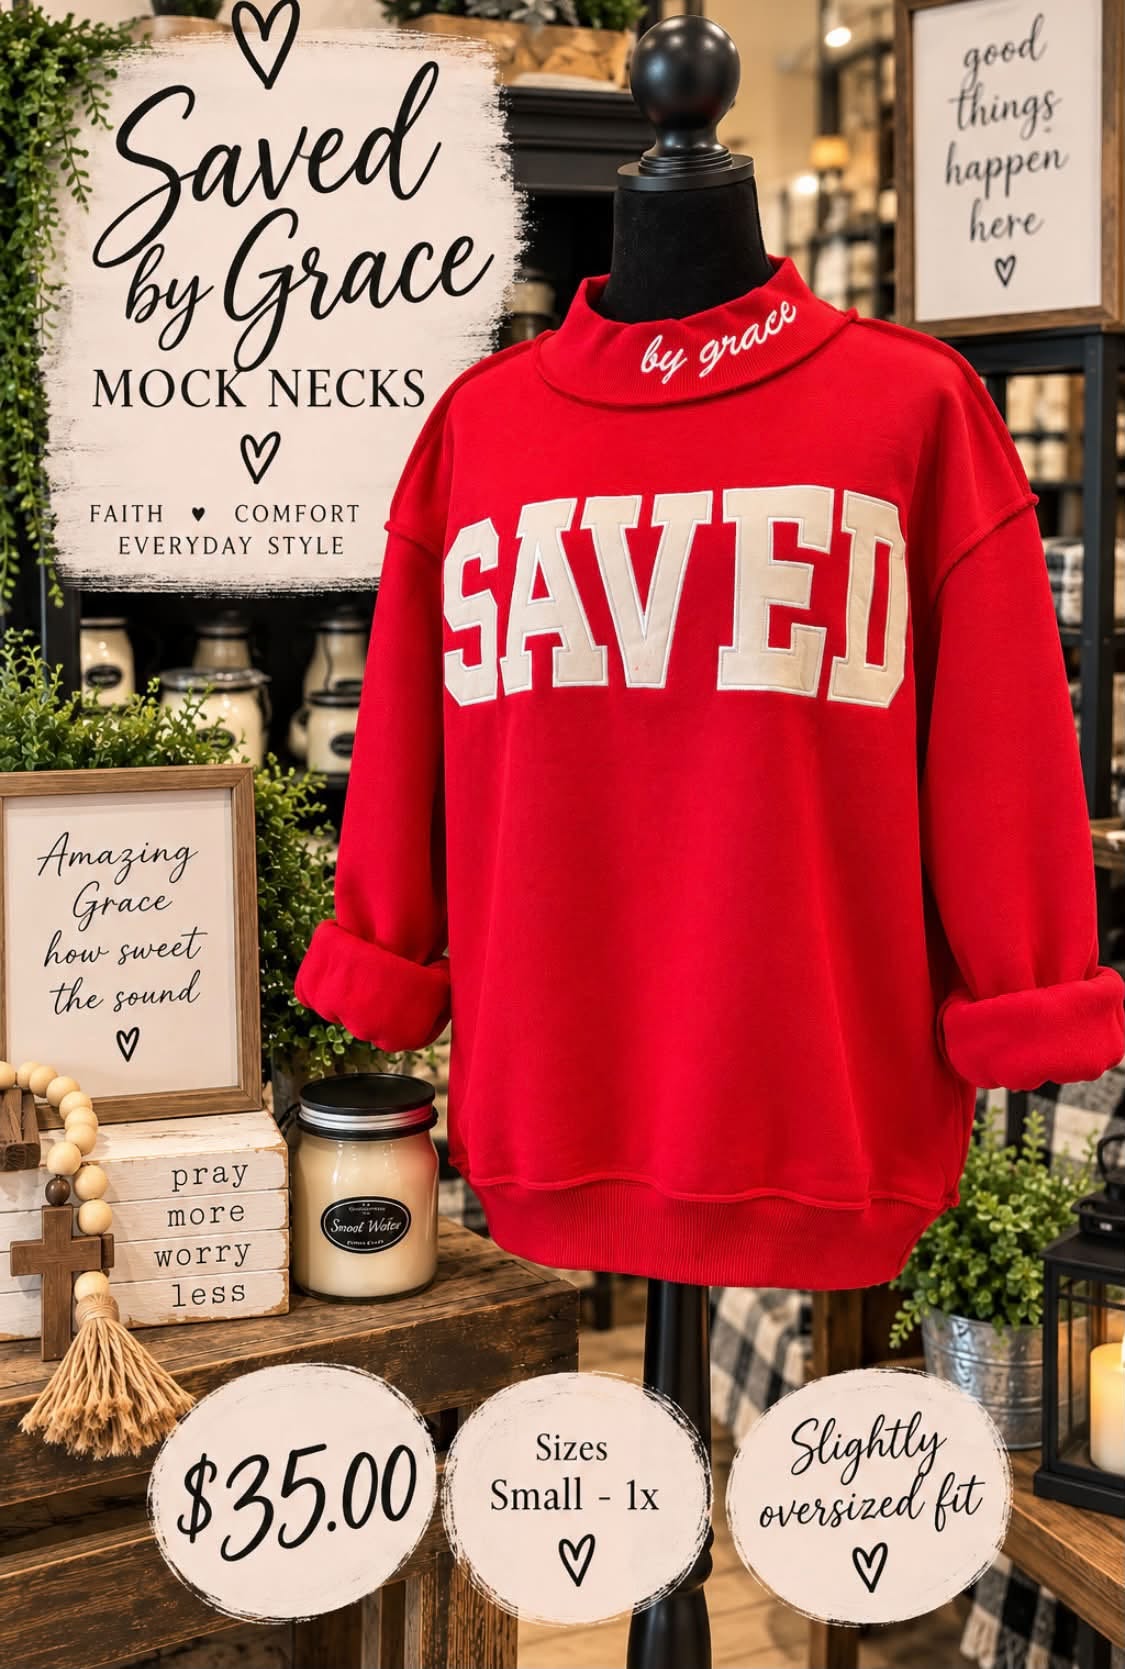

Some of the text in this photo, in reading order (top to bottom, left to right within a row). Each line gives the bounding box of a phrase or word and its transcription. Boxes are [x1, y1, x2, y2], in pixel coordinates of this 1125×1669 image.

[962, 13, 1047, 92] good
[948, 82, 1062, 141] things
[945, 142, 1068, 200] happen
[970, 198, 1045, 243] here
[640, 300, 797, 385] by grace
[442, 485, 907, 708] SAVED
[37, 831, 199, 884] Amazing
[72, 880, 172, 932] Grace
[44, 926, 208, 967] how sweet
[49, 969, 201, 1016] the sound
[171, 1163, 249, 1192] pray
[167, 1203, 245, 1228] more
[154, 1243, 251, 1268] worry
[171, 1283, 246, 1308] less
